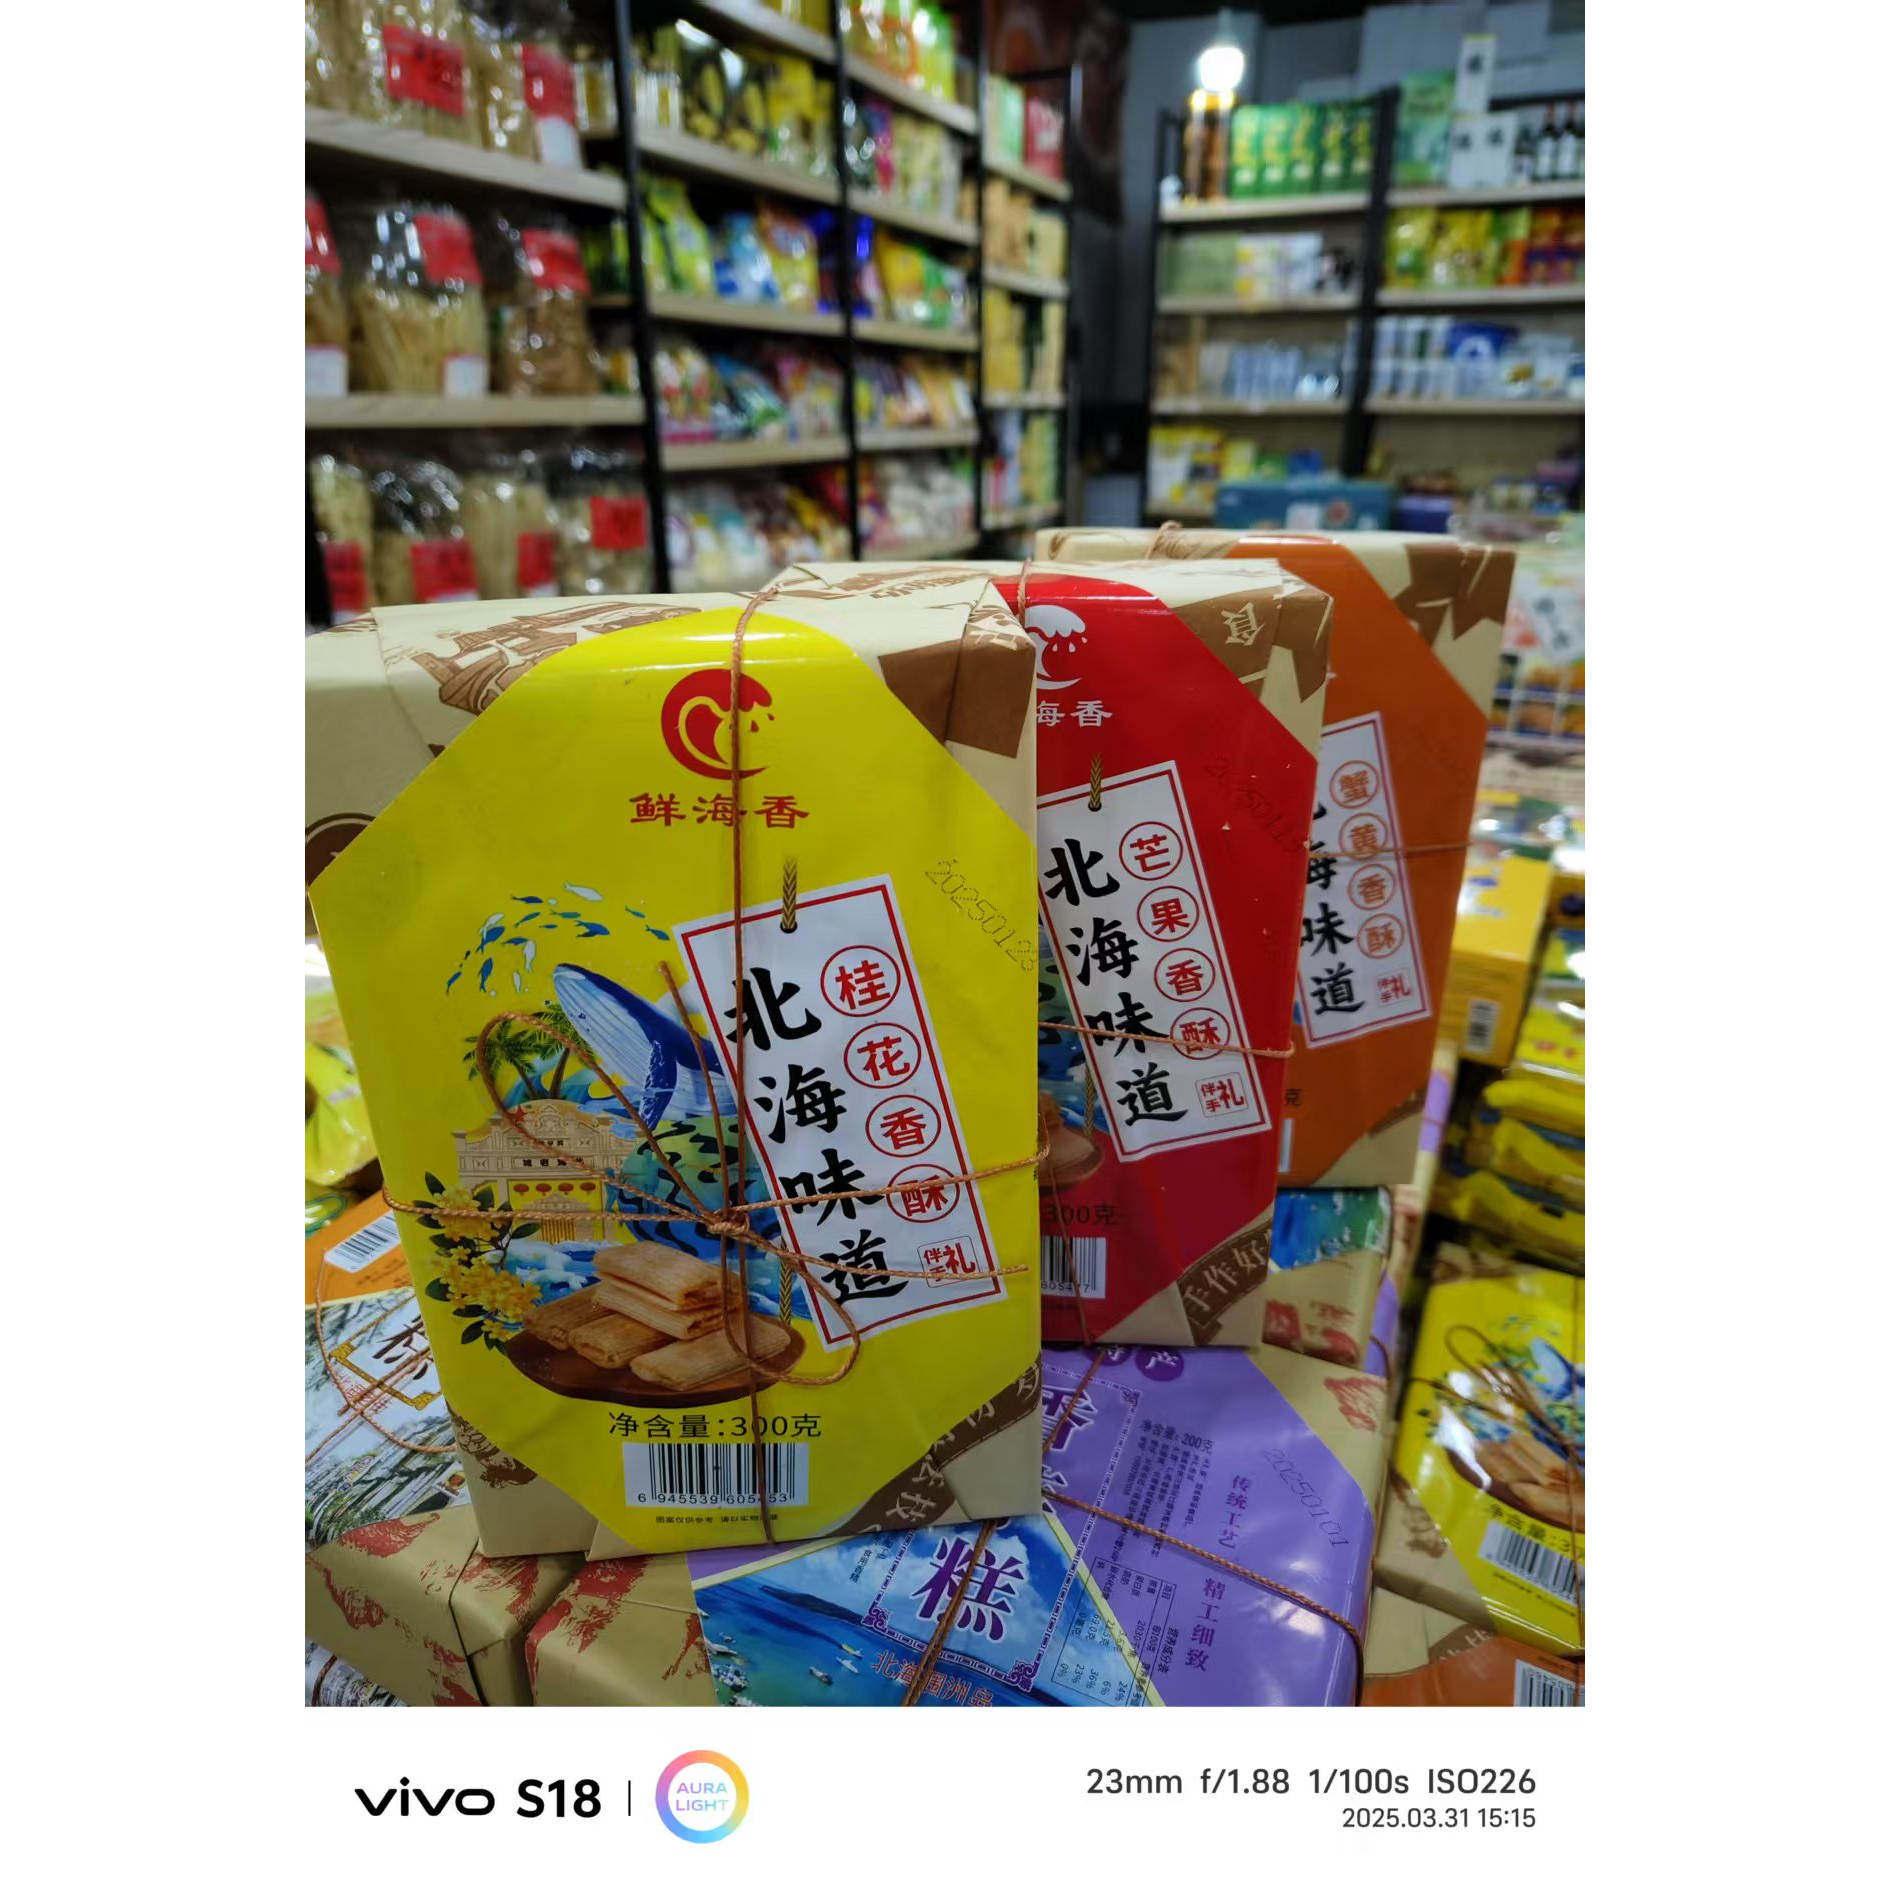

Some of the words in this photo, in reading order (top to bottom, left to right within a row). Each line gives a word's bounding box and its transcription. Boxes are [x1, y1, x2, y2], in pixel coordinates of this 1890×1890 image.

[629, 792, 810, 829] 鲜海香
[1129, 833, 1222, 1056] 芒果香酥
[1300, 802, 1365, 1016] 海味道
[1043, 838, 1189, 1127] 北海味道
[724, 967, 909, 1305] 北海味道
[834, 959, 950, 1218] 桂花香酥
[608, 1411, 822, 1439] 净含量:300克
[637, 1493, 647, 1503] 6
[657, 1493, 719, 1505] 945539
[726, 1493, 788, 1505] 60553
[1218, 1474, 1250, 1549] 传统工艺
[911, 1535, 1026, 1642] 糕
[1184, 1577, 1227, 1672] 精工细致
